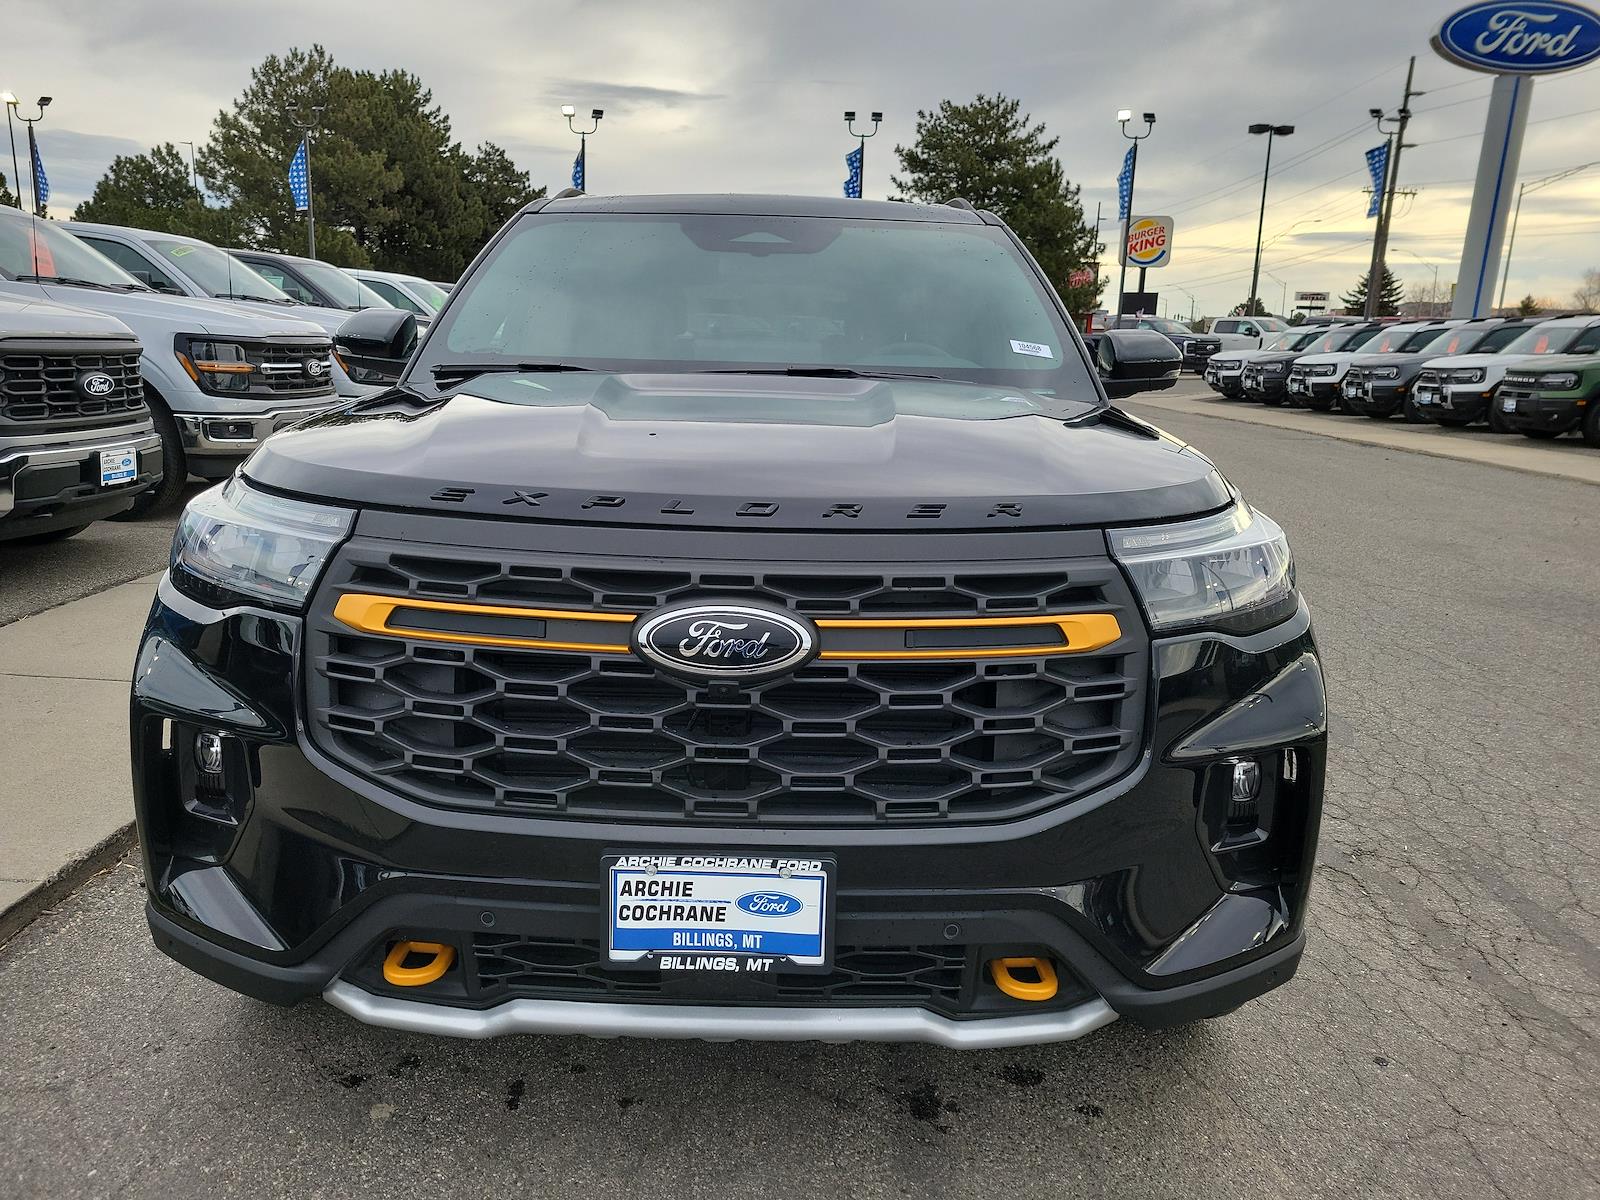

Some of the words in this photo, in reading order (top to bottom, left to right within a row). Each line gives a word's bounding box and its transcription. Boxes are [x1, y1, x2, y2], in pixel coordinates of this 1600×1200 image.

[1475, 10, 1583, 57] Ford
[1127, 226, 1165, 242] BURGER
[1127, 234, 1166, 255] KING
[91, 378, 110, 392] Ford
[430, 487, 1023, 518] EXPLORER
[679, 620, 771, 659] Ford
[616, 856, 677, 867] ARCHIE
[680, 857, 772, 869] COCHRANE
[777, 861, 822, 871] FORD
[620, 880, 694, 897] ARCHIE
[749, 894, 789, 913] Ford
[619, 904, 727, 922] COCHRANE
[673, 932, 738, 949] BILLINGS,
[742, 934, 763, 949] MT
[659, 956, 740, 972] BILLINGS,
[746, 958, 773, 972] MT
